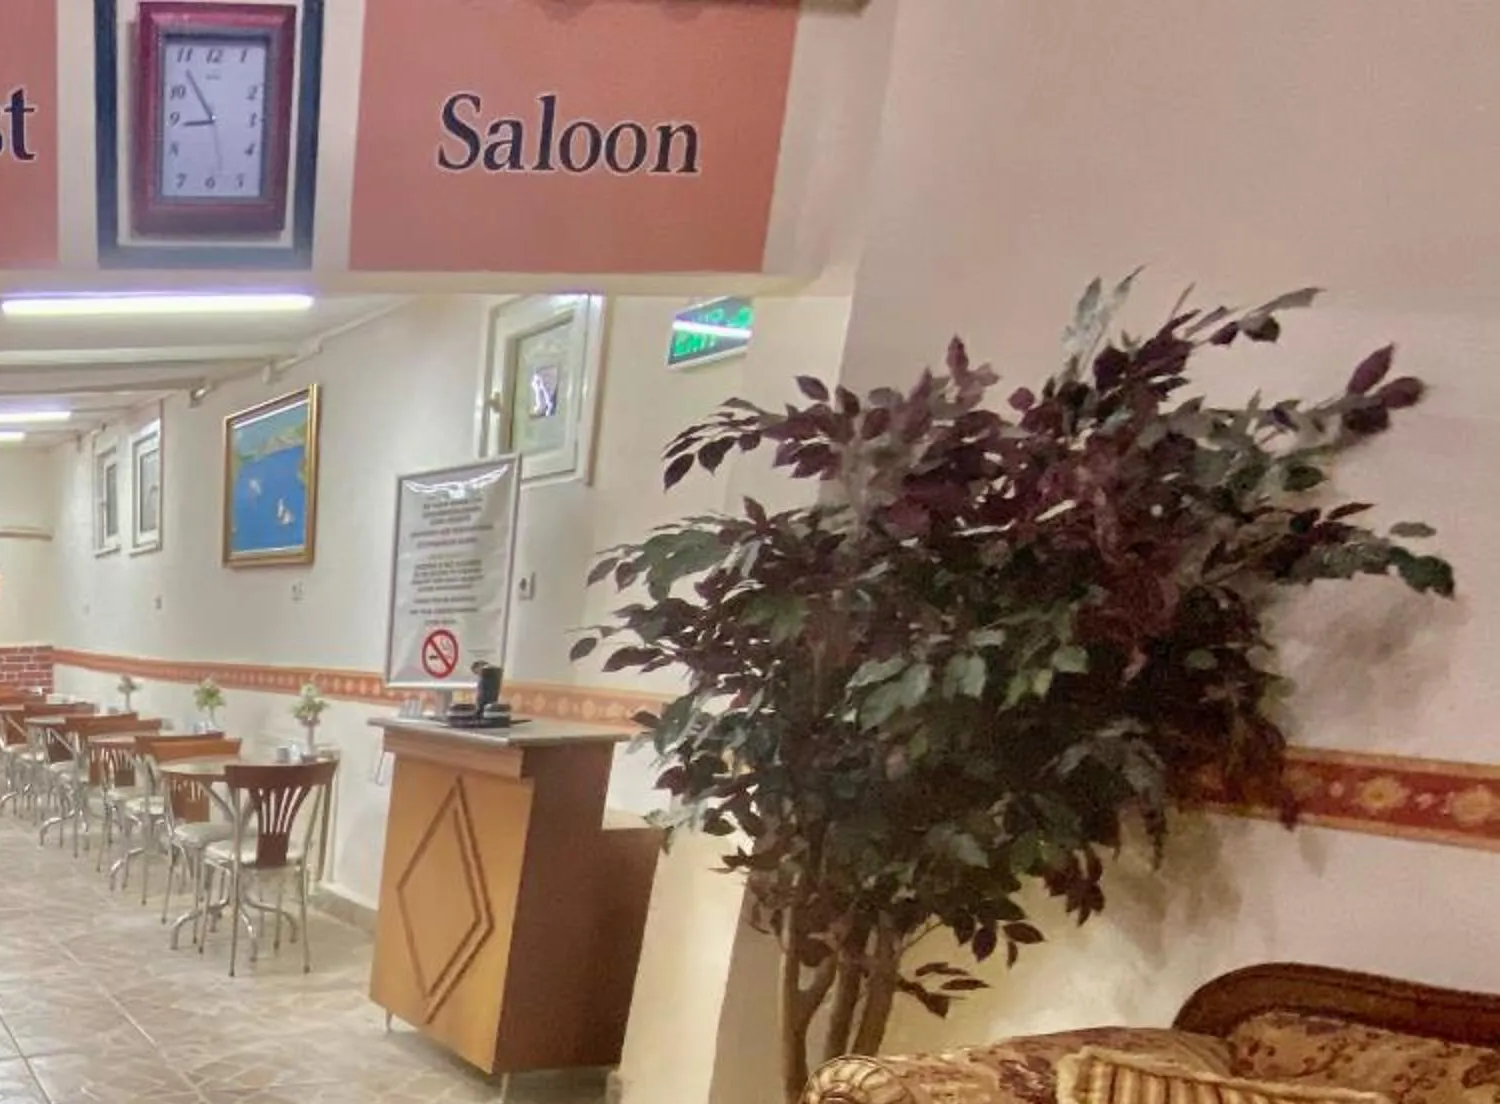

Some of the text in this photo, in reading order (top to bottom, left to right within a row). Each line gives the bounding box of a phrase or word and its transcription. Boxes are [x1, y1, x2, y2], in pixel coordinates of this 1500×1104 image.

[176, 48, 194, 63] 11
[206, 49, 223, 63] 12
[169, 84, 187, 99] 10
[247, 86, 258, 100] 2
[169, 111, 181, 126] 9
[437, 92, 699, 174] Saloon
[204, 176, 216, 188] 6
